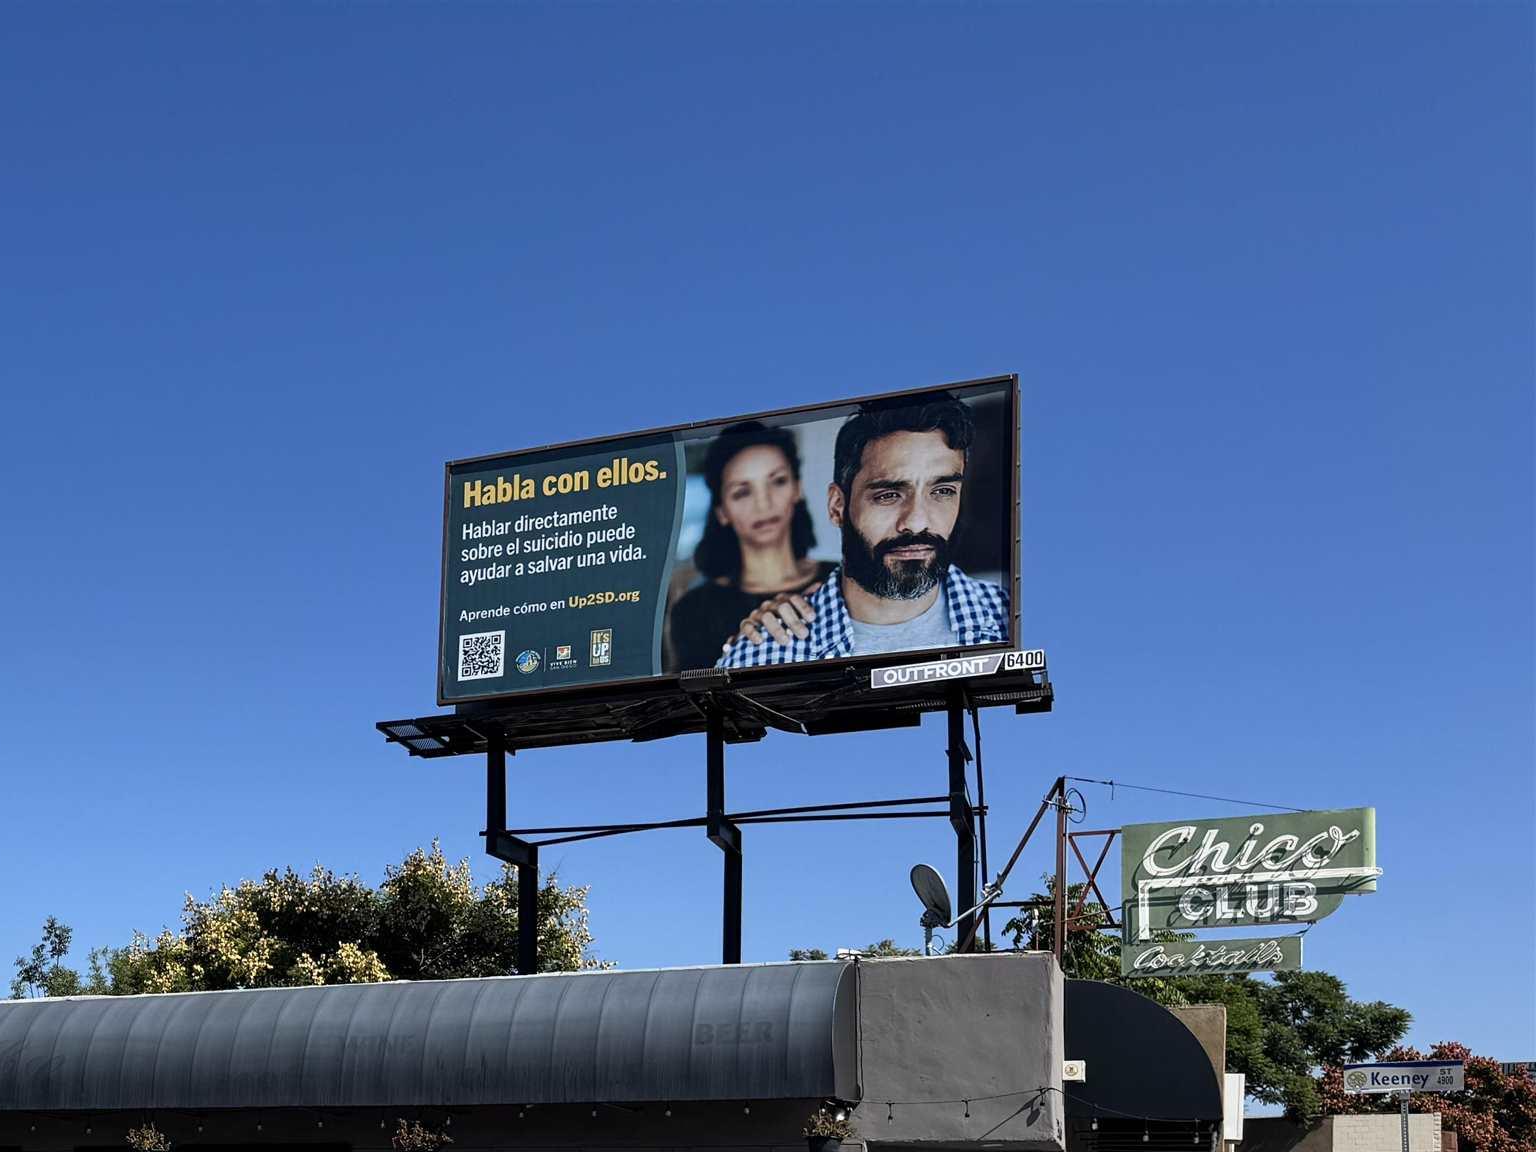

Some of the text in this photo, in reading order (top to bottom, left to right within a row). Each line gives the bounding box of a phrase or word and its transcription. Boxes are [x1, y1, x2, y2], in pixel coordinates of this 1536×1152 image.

[463, 457, 667, 508] Habla con ellos.
[462, 504, 619, 540] Hablar directamente
[461, 523, 636, 562] sobre el suicidio puede
[460, 544, 647, 586] ayudar a salvar una vida.
[459, 590, 640, 622] Aprende cómo en Up2SD.org
[593, 642, 609, 656] UP
[1007, 651, 1043, 667] 6400
[884, 658, 989, 684] OUTFRONT
[1142, 822, 1360, 876] Chico
[1179, 881, 1319, 920] CLUB
[1134, 940, 1284, 970] Cocktails
[1371, 1071, 1429, 1088] Keeney
